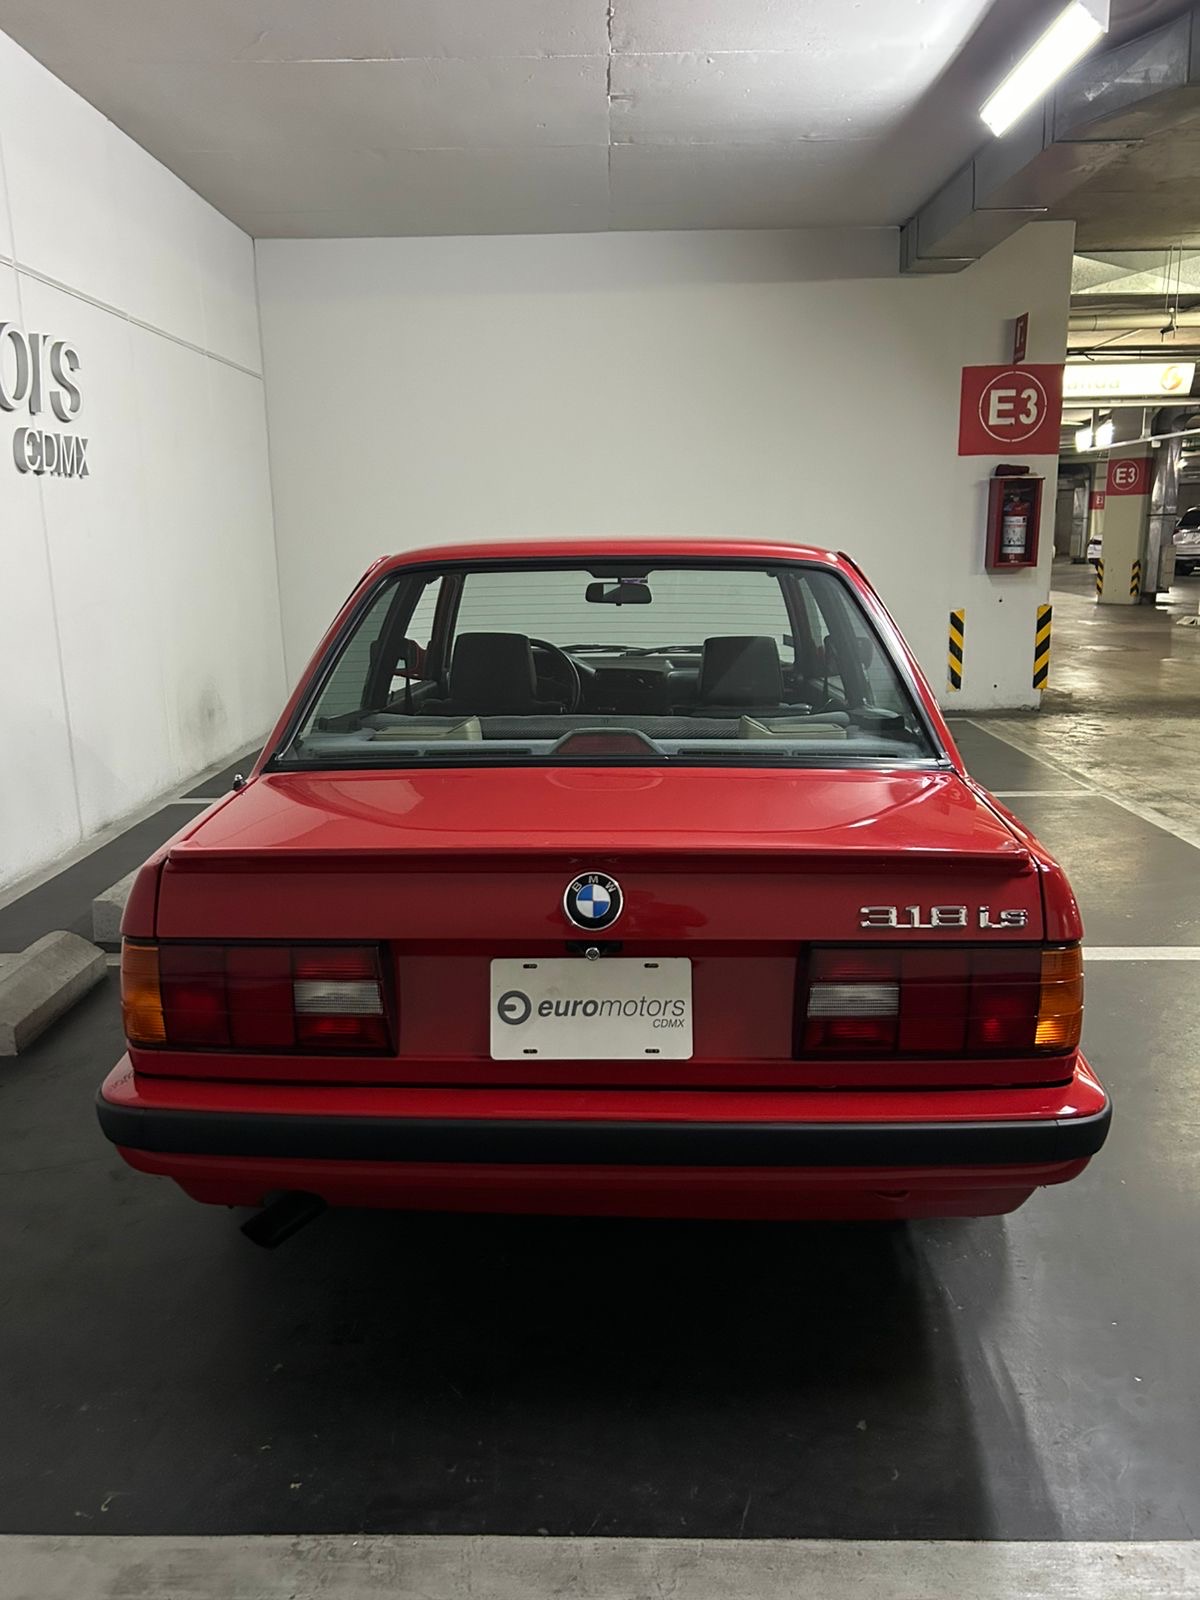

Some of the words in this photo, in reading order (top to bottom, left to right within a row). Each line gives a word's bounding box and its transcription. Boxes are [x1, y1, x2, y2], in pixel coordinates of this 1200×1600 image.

[988, 388, 1038, 426] E3
[15, 427, 89, 477] CDMX
[1115, 467, 1136, 484] E3
[572, 875, 617, 894] BMW
[538, 995, 686, 1018] euromotors
[652, 1018, 686, 1029] CDMX
